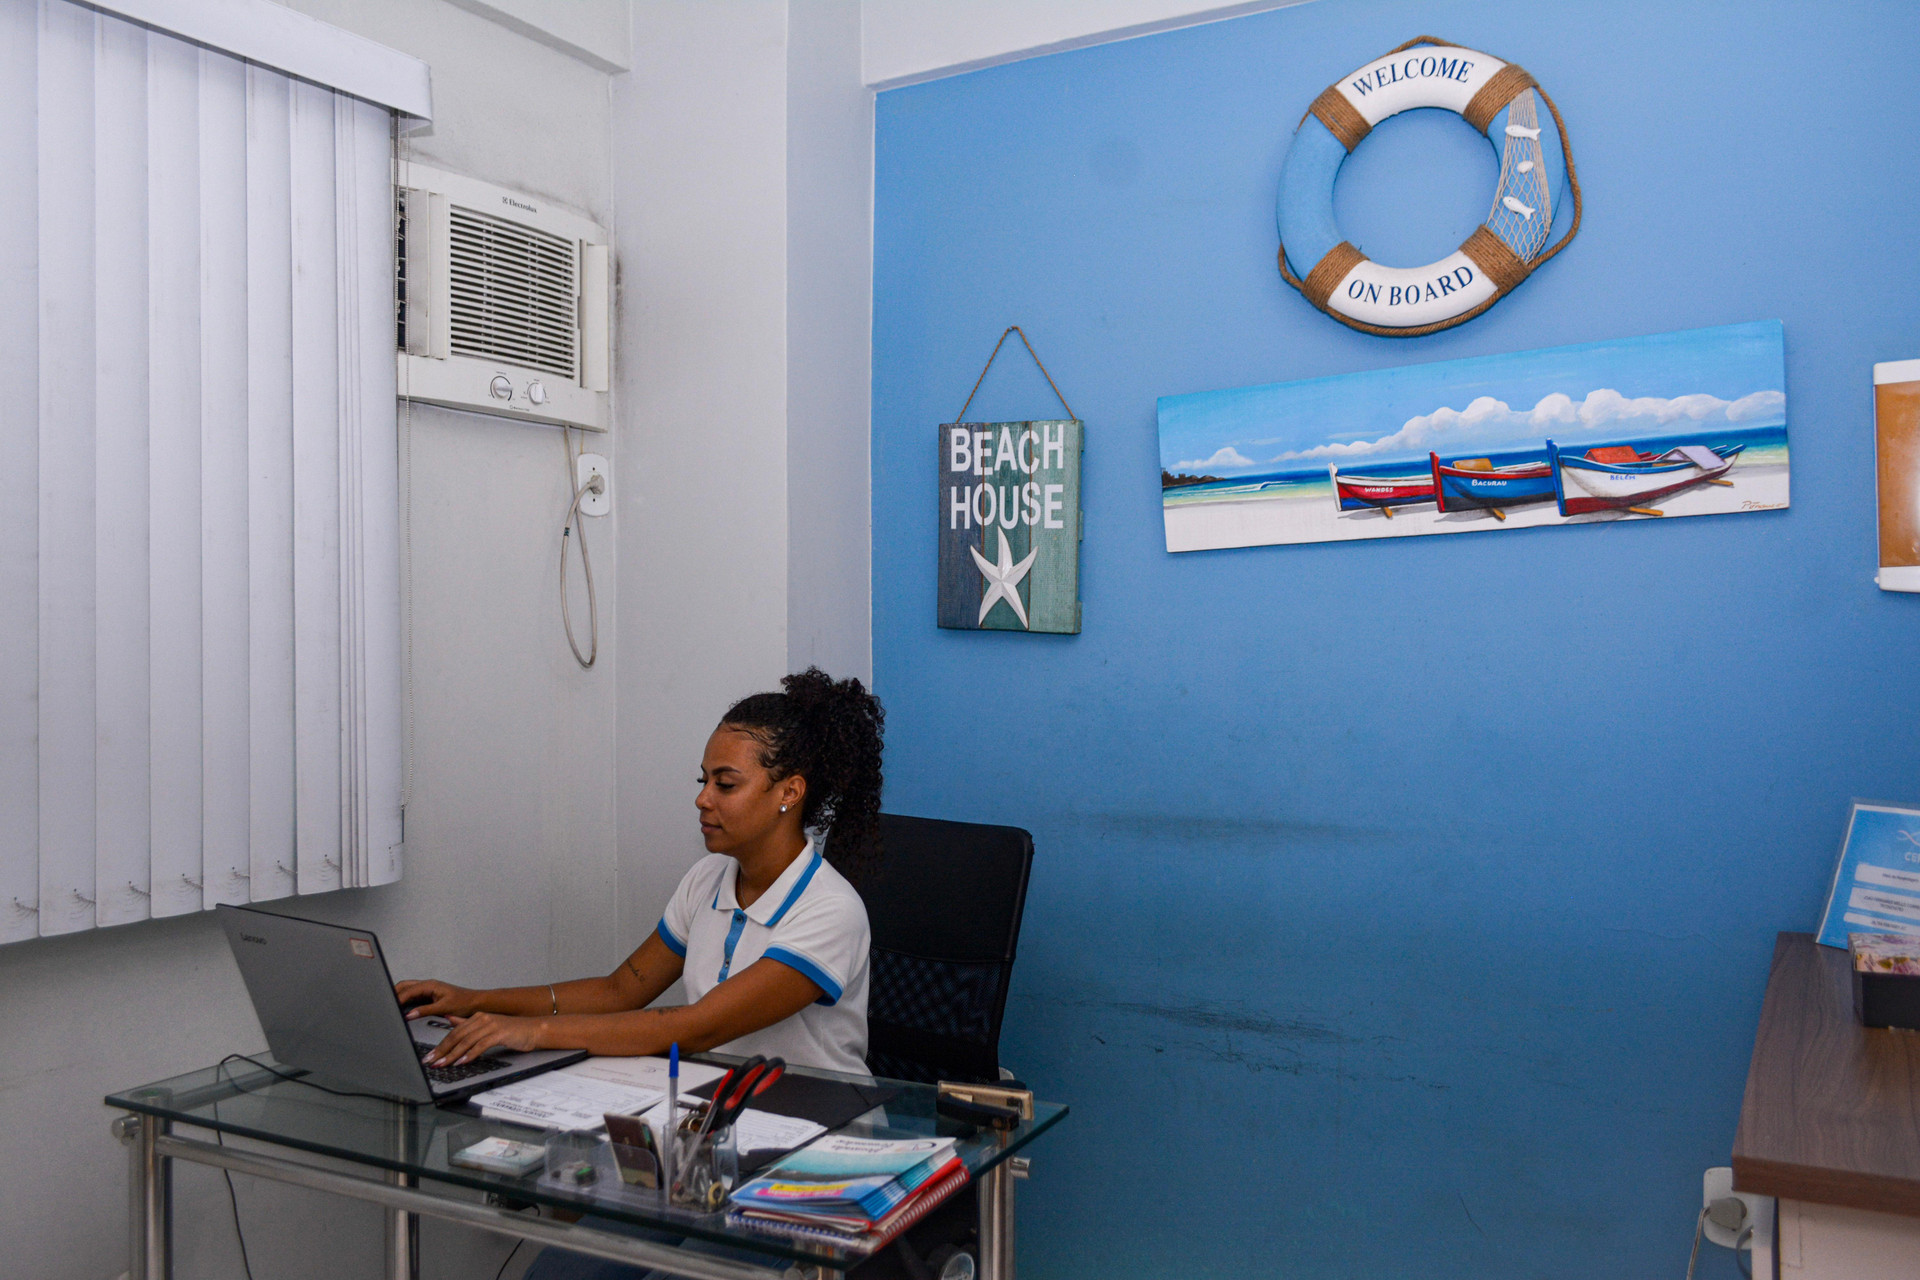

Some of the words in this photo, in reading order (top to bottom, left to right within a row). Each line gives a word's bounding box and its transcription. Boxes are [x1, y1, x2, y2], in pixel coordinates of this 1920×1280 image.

[1352, 57, 1475, 96] WELCOME
[509, 198, 537, 213] Electrolux
[1348, 279, 1382, 304] ON
[1388, 266, 1474, 306] BOARD
[950, 424, 1064, 475] BEACH
[950, 481, 1064, 530] HOUSE
